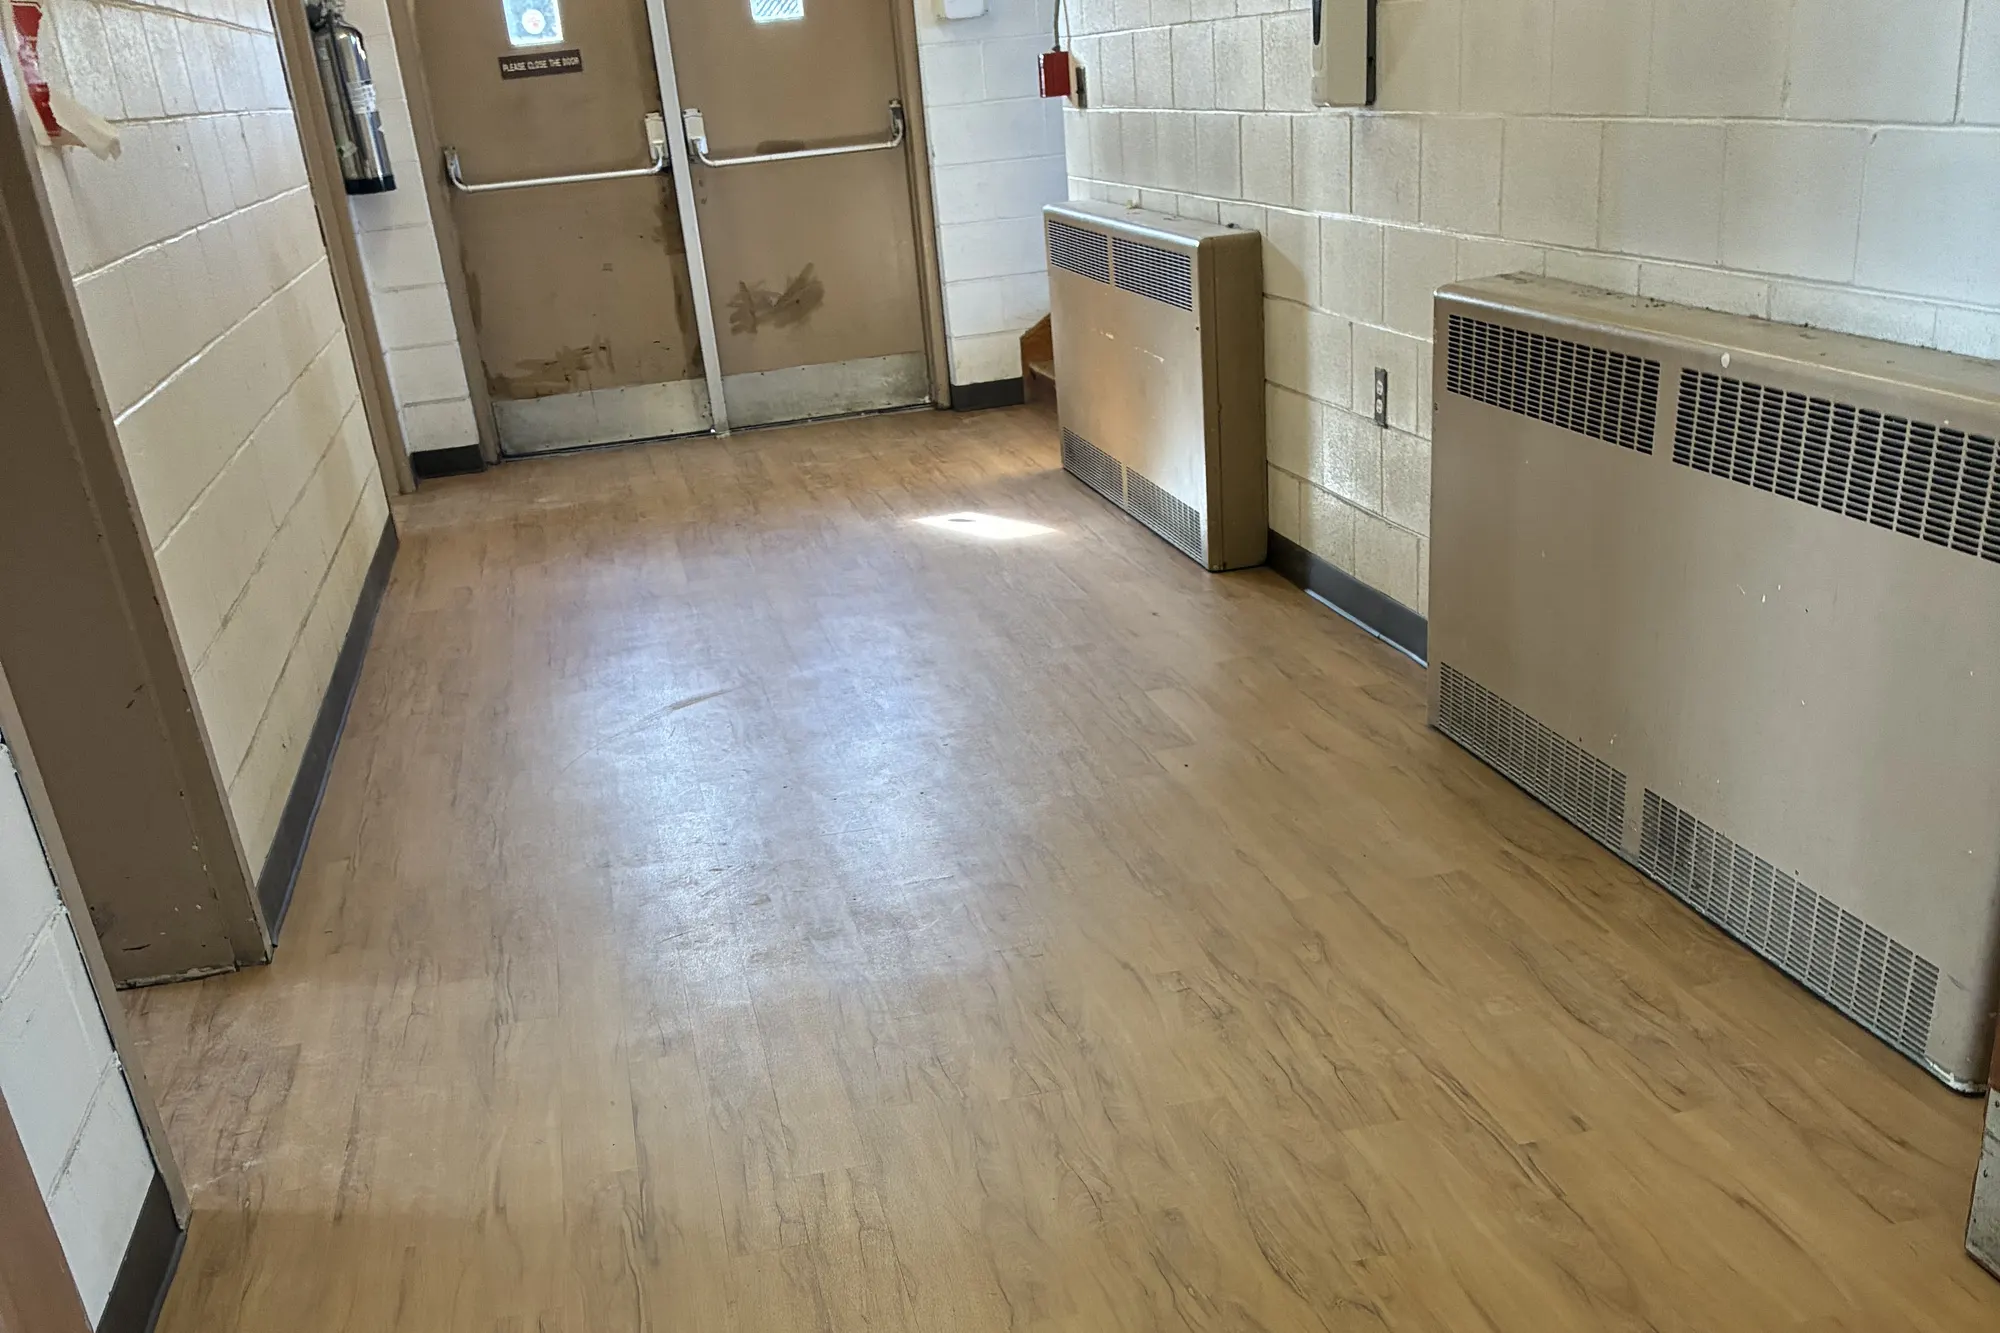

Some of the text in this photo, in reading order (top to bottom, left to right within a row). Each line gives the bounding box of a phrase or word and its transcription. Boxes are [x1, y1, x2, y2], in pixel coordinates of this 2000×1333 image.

[503, 57, 579, 72] PLEASE CLOSE THE DOOR
